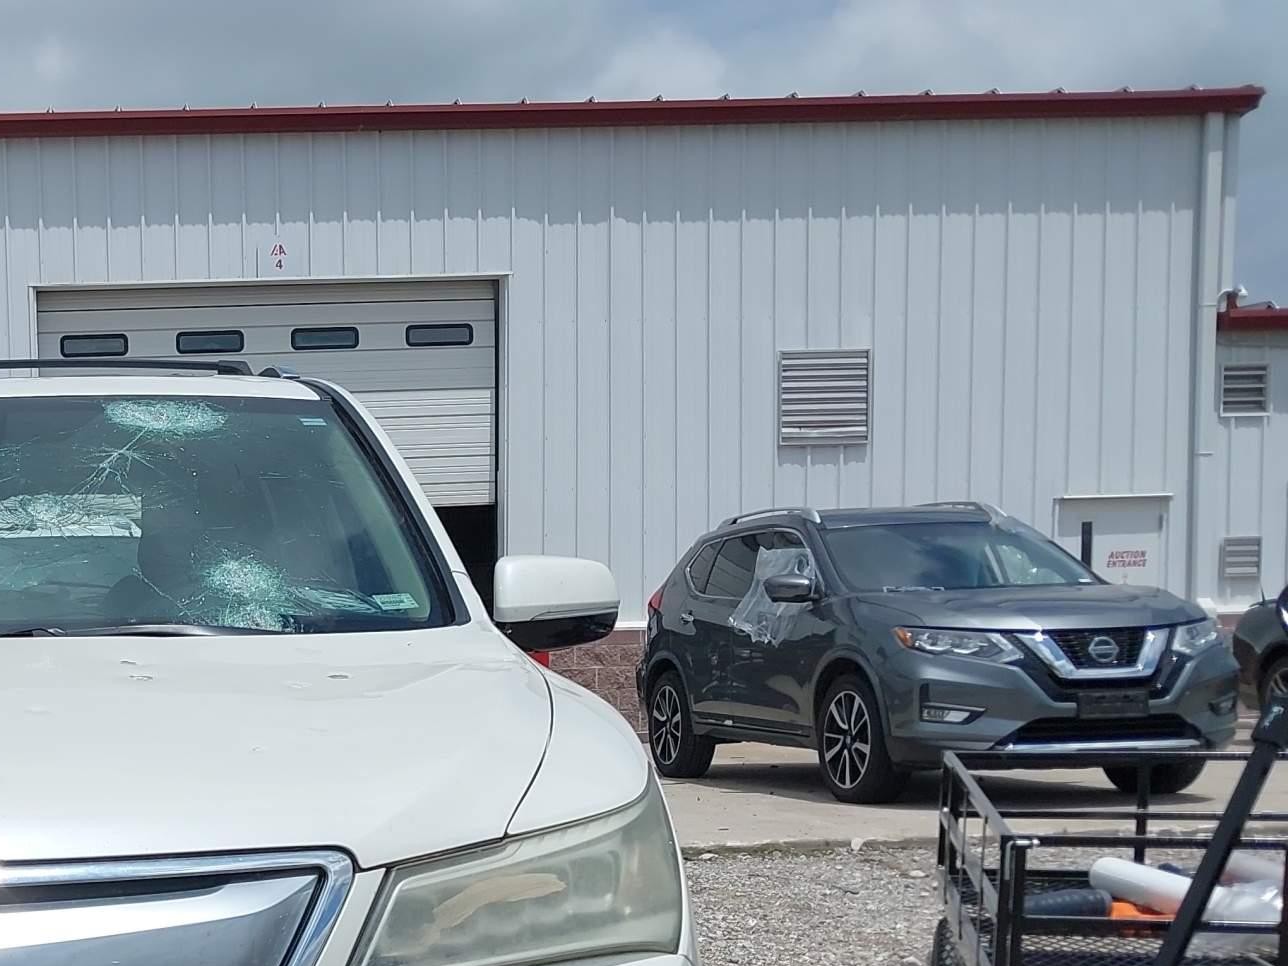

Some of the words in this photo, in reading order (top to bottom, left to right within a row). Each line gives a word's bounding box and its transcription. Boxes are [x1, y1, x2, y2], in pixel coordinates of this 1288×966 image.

[275, 259, 283, 270] 4
[1108, 550, 1147, 559] AUCTION
[1106, 559, 1147, 568] ENTRANCE
